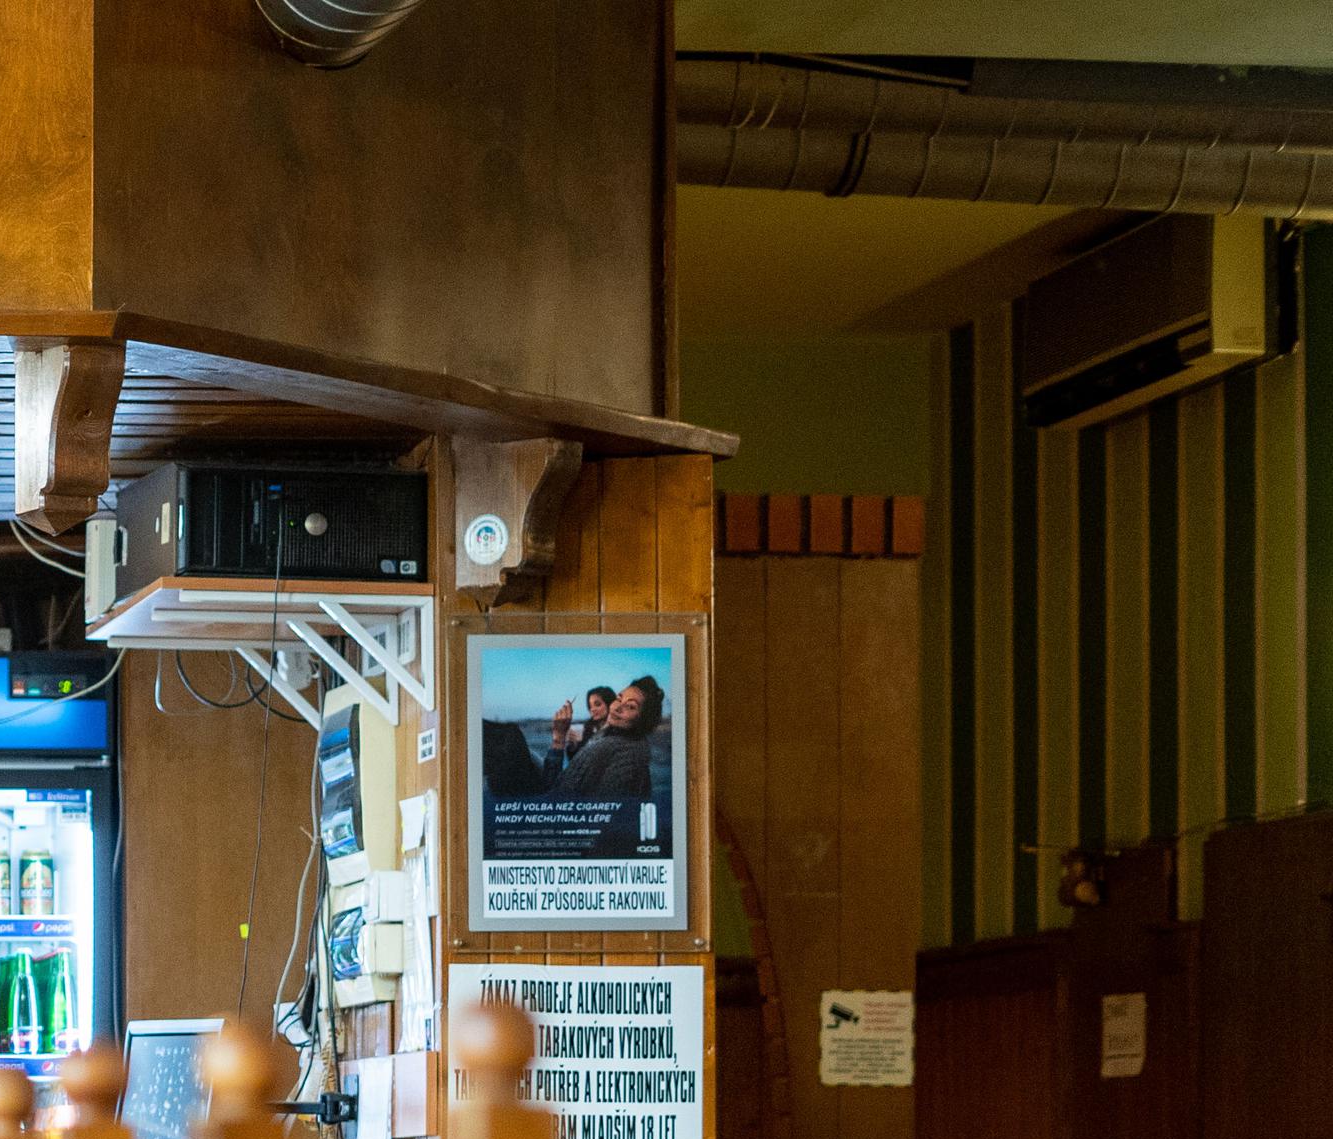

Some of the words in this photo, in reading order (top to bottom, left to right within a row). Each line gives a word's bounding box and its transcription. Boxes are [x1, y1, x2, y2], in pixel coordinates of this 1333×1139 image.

[495, 801, 521, 811] LEPŠÍ
[523, 802, 554, 811] VOLBA
[555, 801, 574, 811] NEŽ
[576, 802, 622, 811] CIGARETY
[495, 814, 523, 823] NIKDY
[525, 814, 586, 823] NECHUTNALA
[588, 813, 612, 823] LÉPE
[488, 866, 555, 885] MINISTERSTVO
[558, 862, 628, 885] ZDRAVOTNICTVÍ
[629, 866, 668, 884] VARUJE:
[488, 889, 538, 911] KOUŘENÍ
[541, 888, 605, 911] ZPŮSOBUJE
[609, 891, 668, 910] RAKOVINU.
[521, 980, 572, 1013] PRODEJE
[577, 976, 672, 1015] ALKOHOLICKÝCH
[538, 1020, 614, 1058] TABÁKOVÝCH
[619, 1020, 677, 1063] VÝROBKŮ,
[536, 1064, 579, 1102] POTŘEB
[584, 1071, 592, 1102] A
[596, 1065, 696, 1103] ELEKTRONICKÝCH
